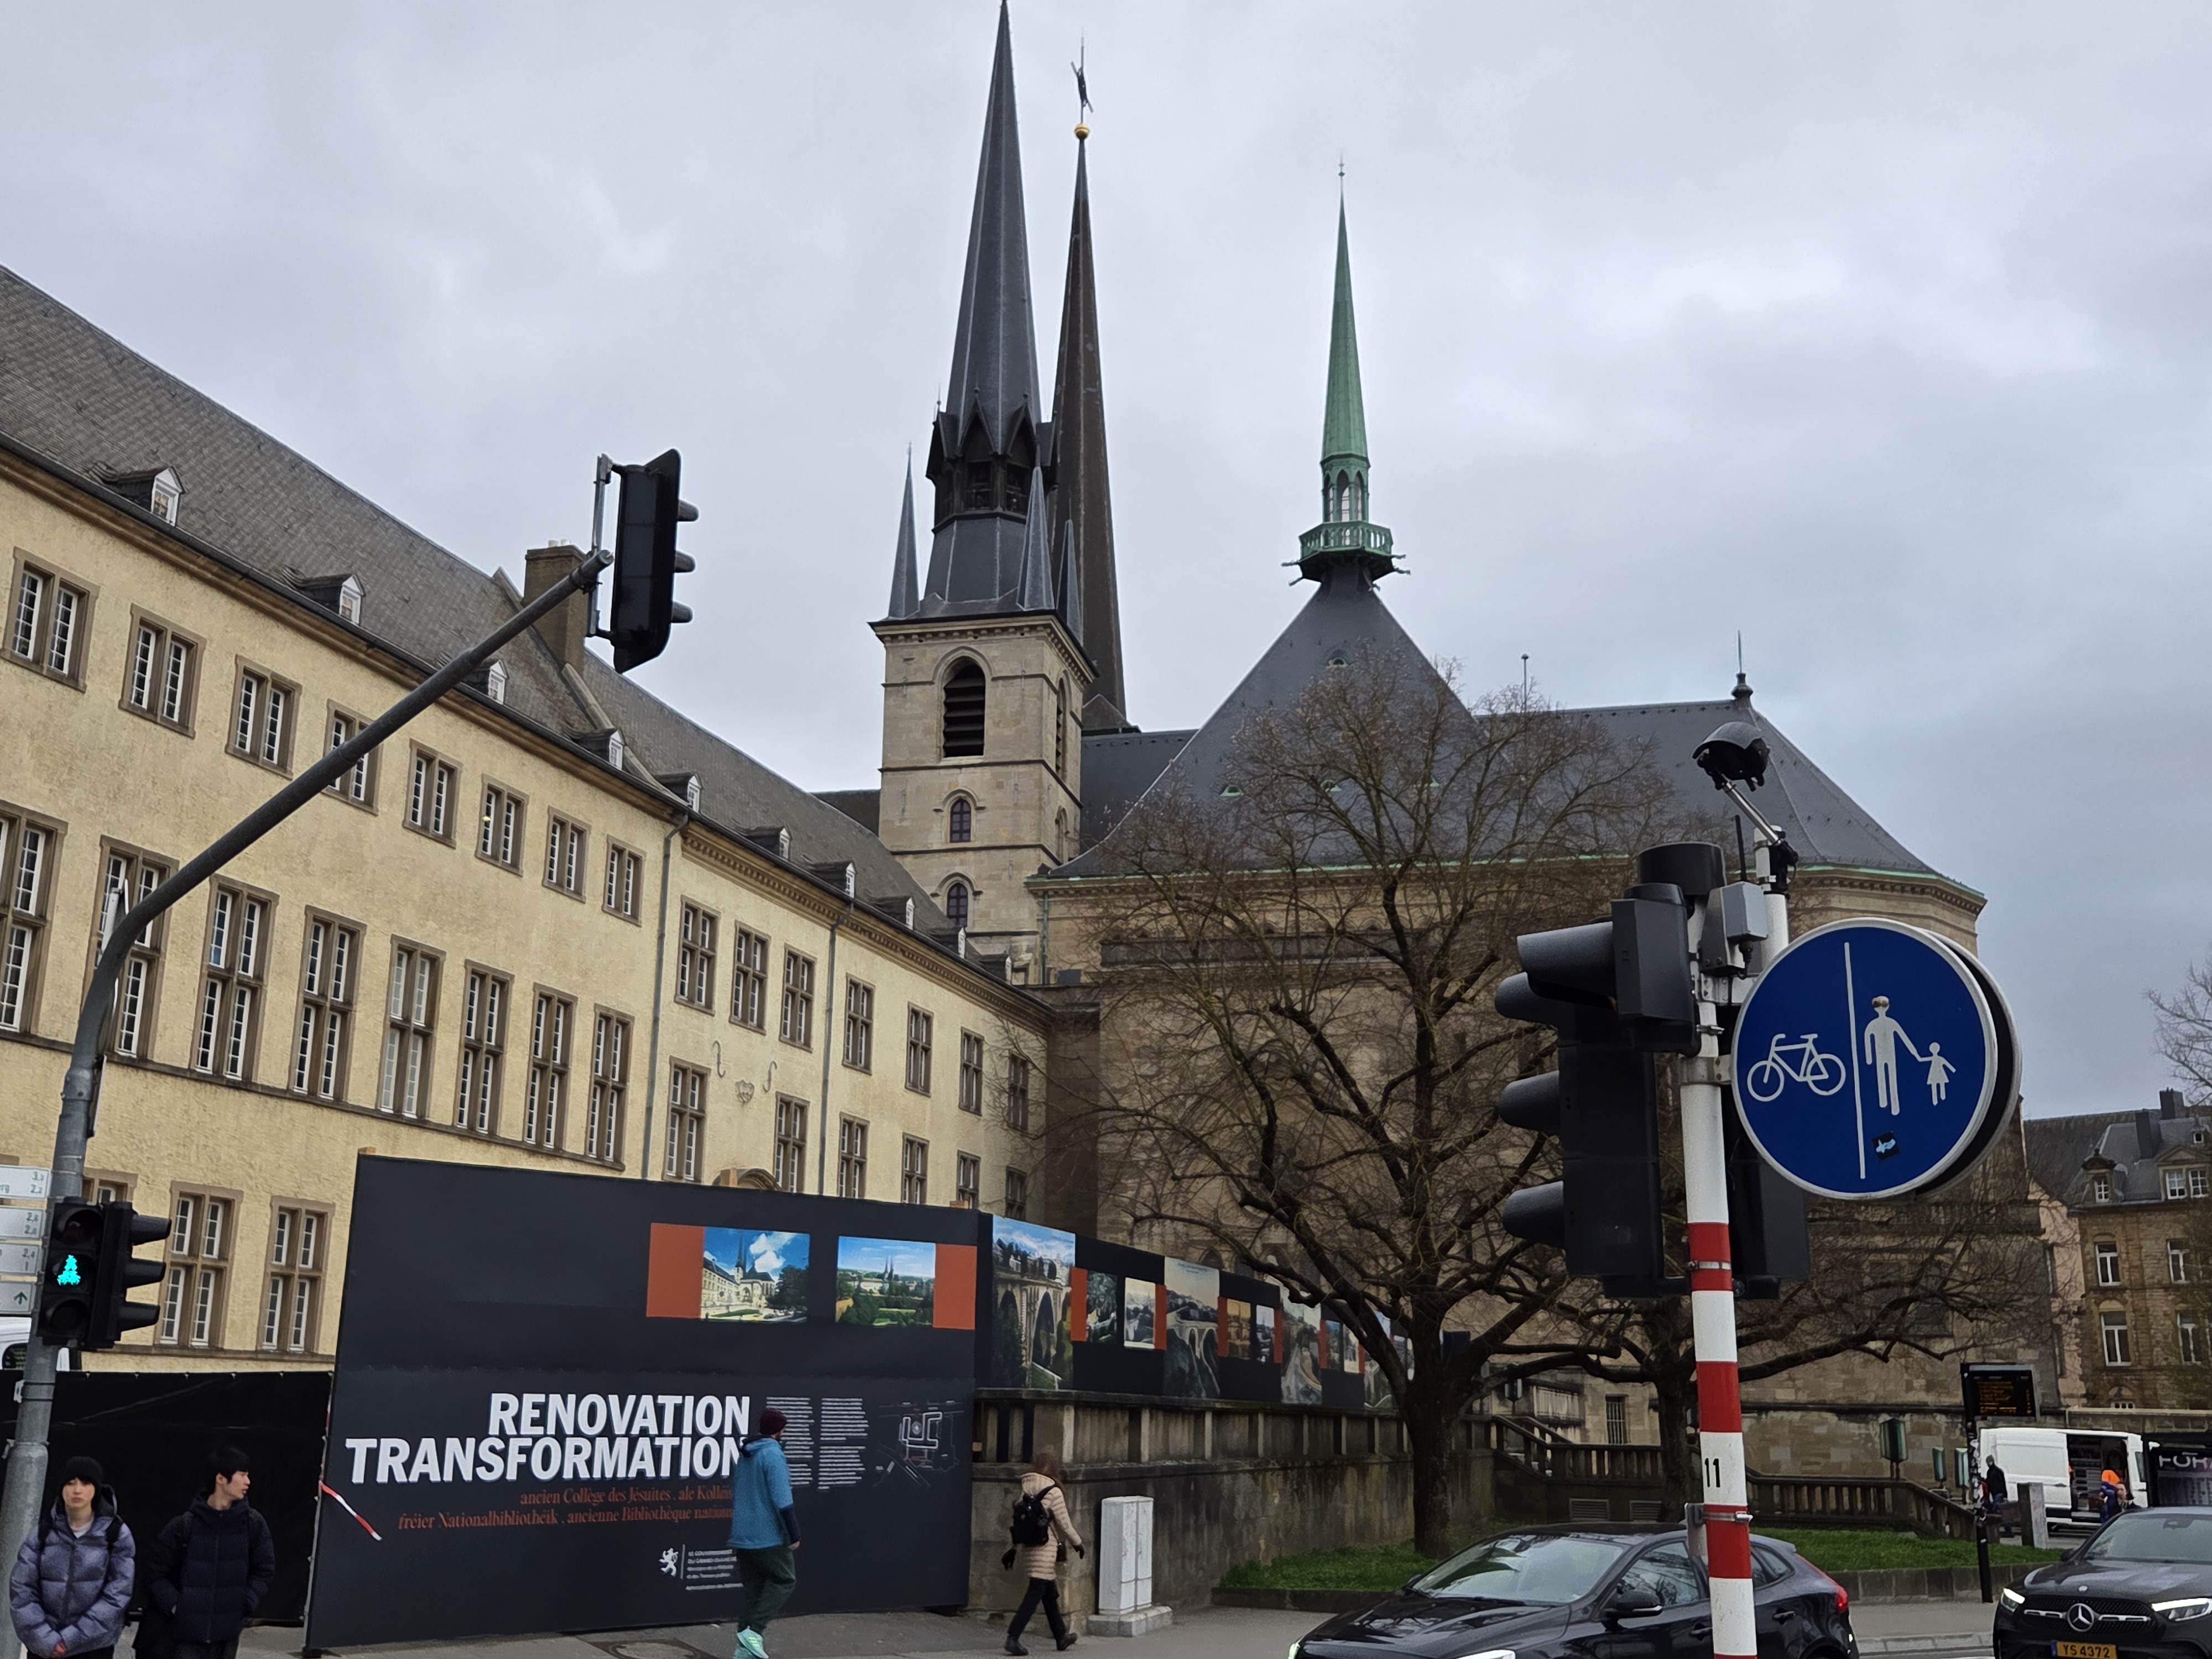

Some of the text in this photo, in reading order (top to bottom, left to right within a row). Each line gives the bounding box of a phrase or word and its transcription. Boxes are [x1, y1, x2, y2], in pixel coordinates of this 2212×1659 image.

[488, 1393, 749, 1436] RENOVATION
[345, 1436, 747, 1484] TRANSFORMATION
[1705, 1458, 1720, 1488] 11
[520, 1490, 560, 1505] ancien
[608, 1487, 626, 1502] des
[629, 1486, 670, 1502] Jésuites
[679, 1486, 694, 1500] ale
[567, 1508, 619, 1524] ancienne
[2063, 1644, 2110, 1658] YS 4372
